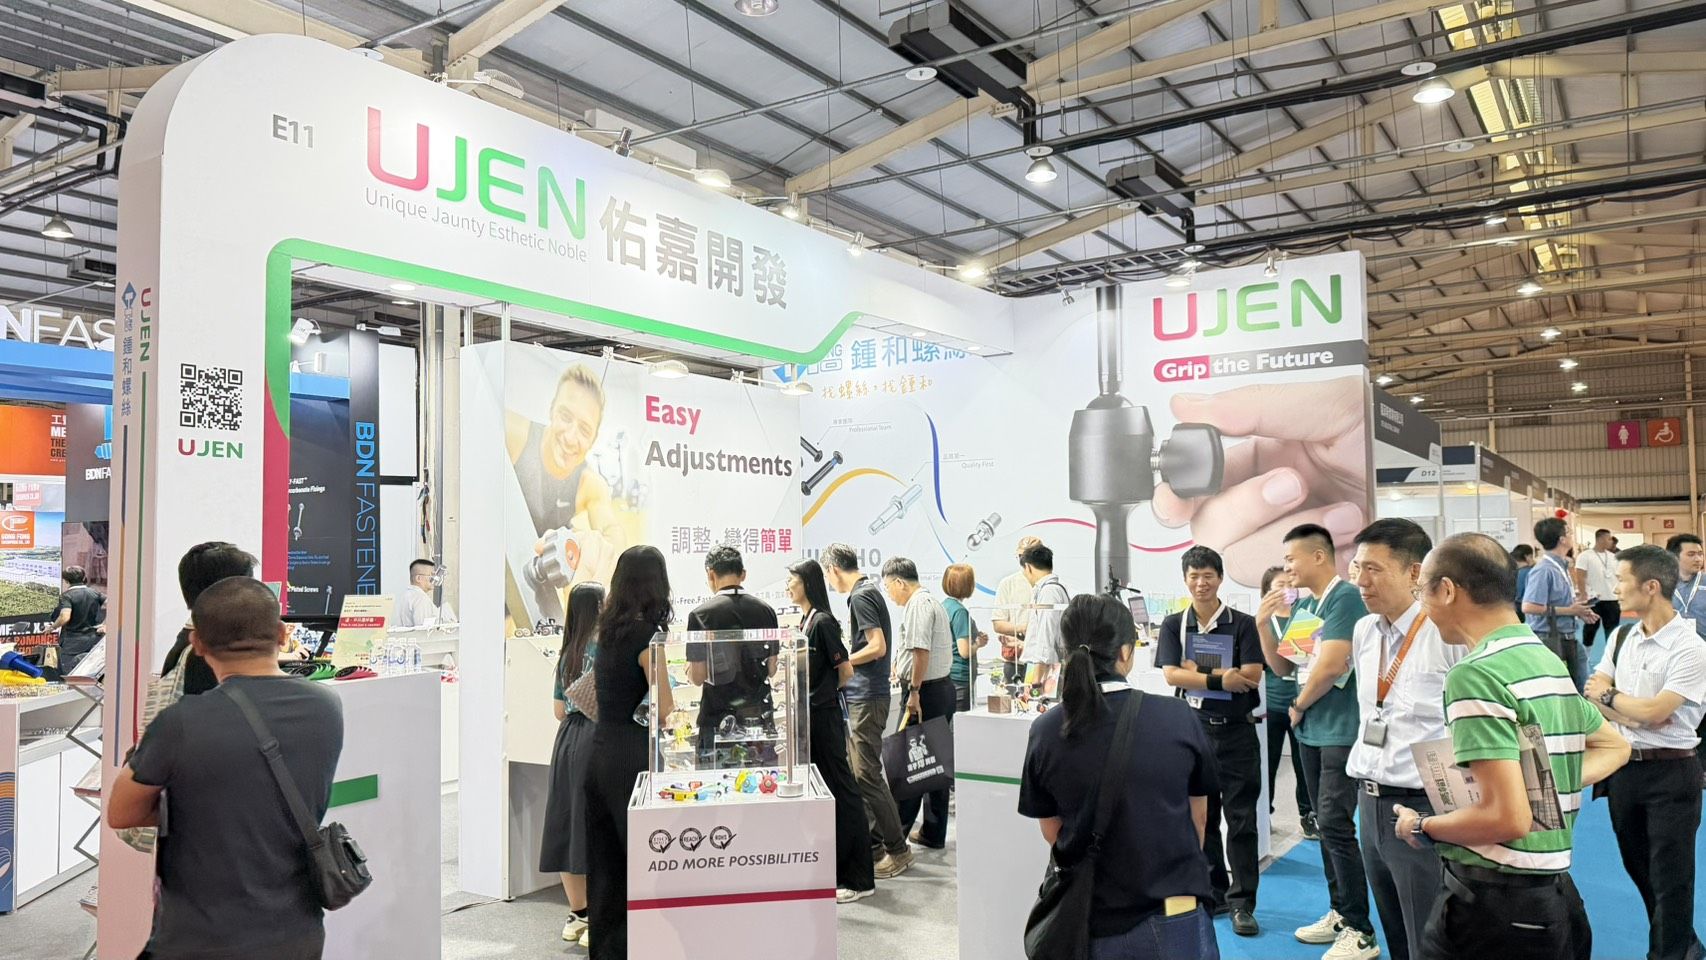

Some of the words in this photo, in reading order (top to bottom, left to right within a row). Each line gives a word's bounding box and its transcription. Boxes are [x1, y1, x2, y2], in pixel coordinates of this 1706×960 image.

[273, 114, 313, 148] E11
[367, 106, 585, 240] UJEN
[366, 187, 428, 218] Unique
[432, 207, 485, 238] Jaunty
[489, 221, 545, 252] Esthetic
[548, 238, 587, 262] Noble
[599, 196, 787, 310] 佑嘉開發
[139, 287, 152, 362] UJEN
[1153, 274, 1342, 341] UJEN
[1161, 362, 1207, 382] Grip
[1213, 357, 1249, 374] the
[1256, 350, 1334, 371] Future
[646, 395, 701, 435] Easy
[178, 438, 243, 459] UJEN
[355, 421, 375, 477] BDN
[645, 441, 792, 477] Adjustments
[648, 860, 678, 872] ADD
[682, 857, 725, 870] MORE
[729, 851, 819, 867] POSSIBILITIES
